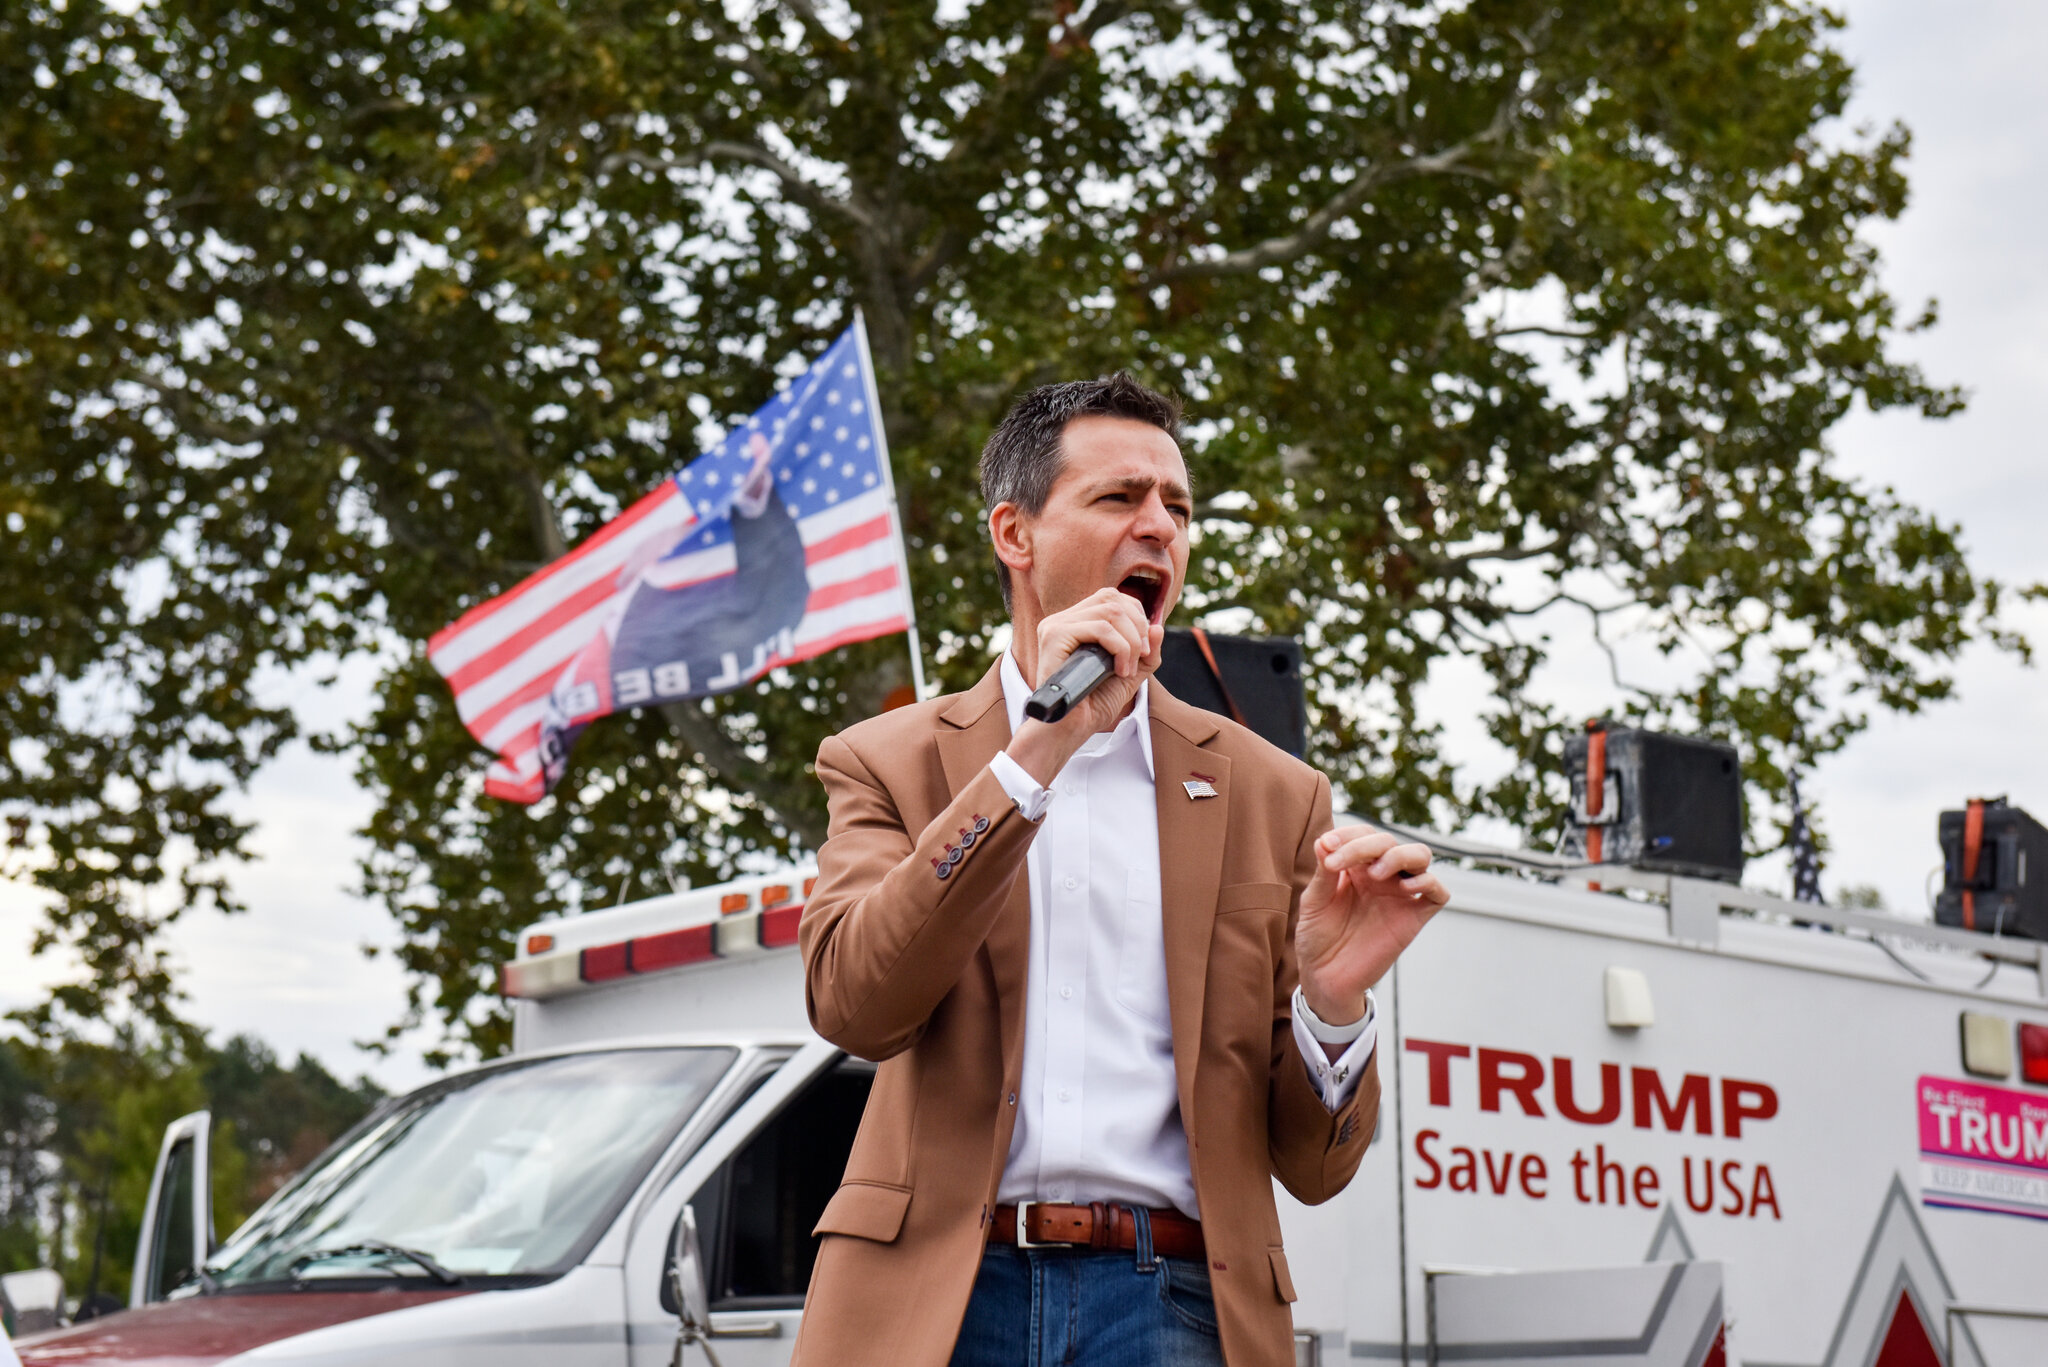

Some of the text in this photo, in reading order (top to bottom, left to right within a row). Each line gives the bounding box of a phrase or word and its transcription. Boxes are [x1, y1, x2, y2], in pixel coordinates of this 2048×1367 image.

[1405, 1037, 1779, 1140] TRUMP
[1414, 1129, 1782, 1221] Save the USA
